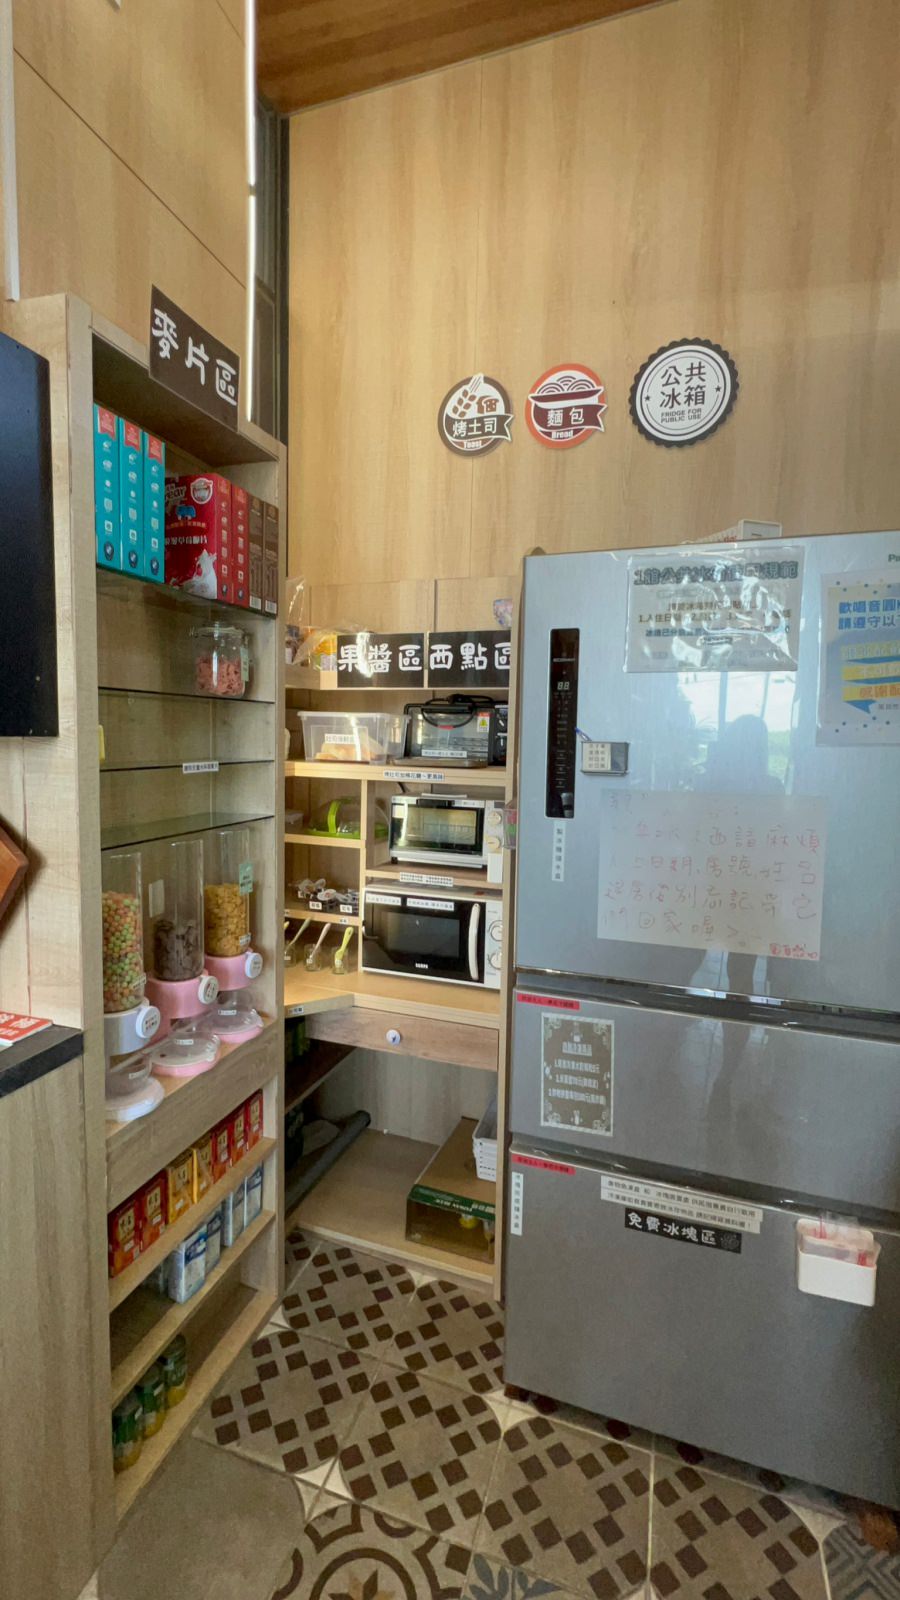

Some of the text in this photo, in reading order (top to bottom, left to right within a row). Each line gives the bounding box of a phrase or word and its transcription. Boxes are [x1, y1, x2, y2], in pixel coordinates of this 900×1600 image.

[151, 308, 237, 406] 麥片區
[660, 361, 706, 387] 公共
[659, 385, 706, 409] 冰箱
[547, 408, 584, 427] 麵包
[660, 408, 702, 418] FRIDGE FOR
[660, 416, 686, 424] PUBLIC
[453, 417, 497, 438] 烤土司
[551, 430, 574, 439] Bread
[337, 642, 422, 673] 果醬區
[627, 1211, 716, 1247] 免費冰塊區
